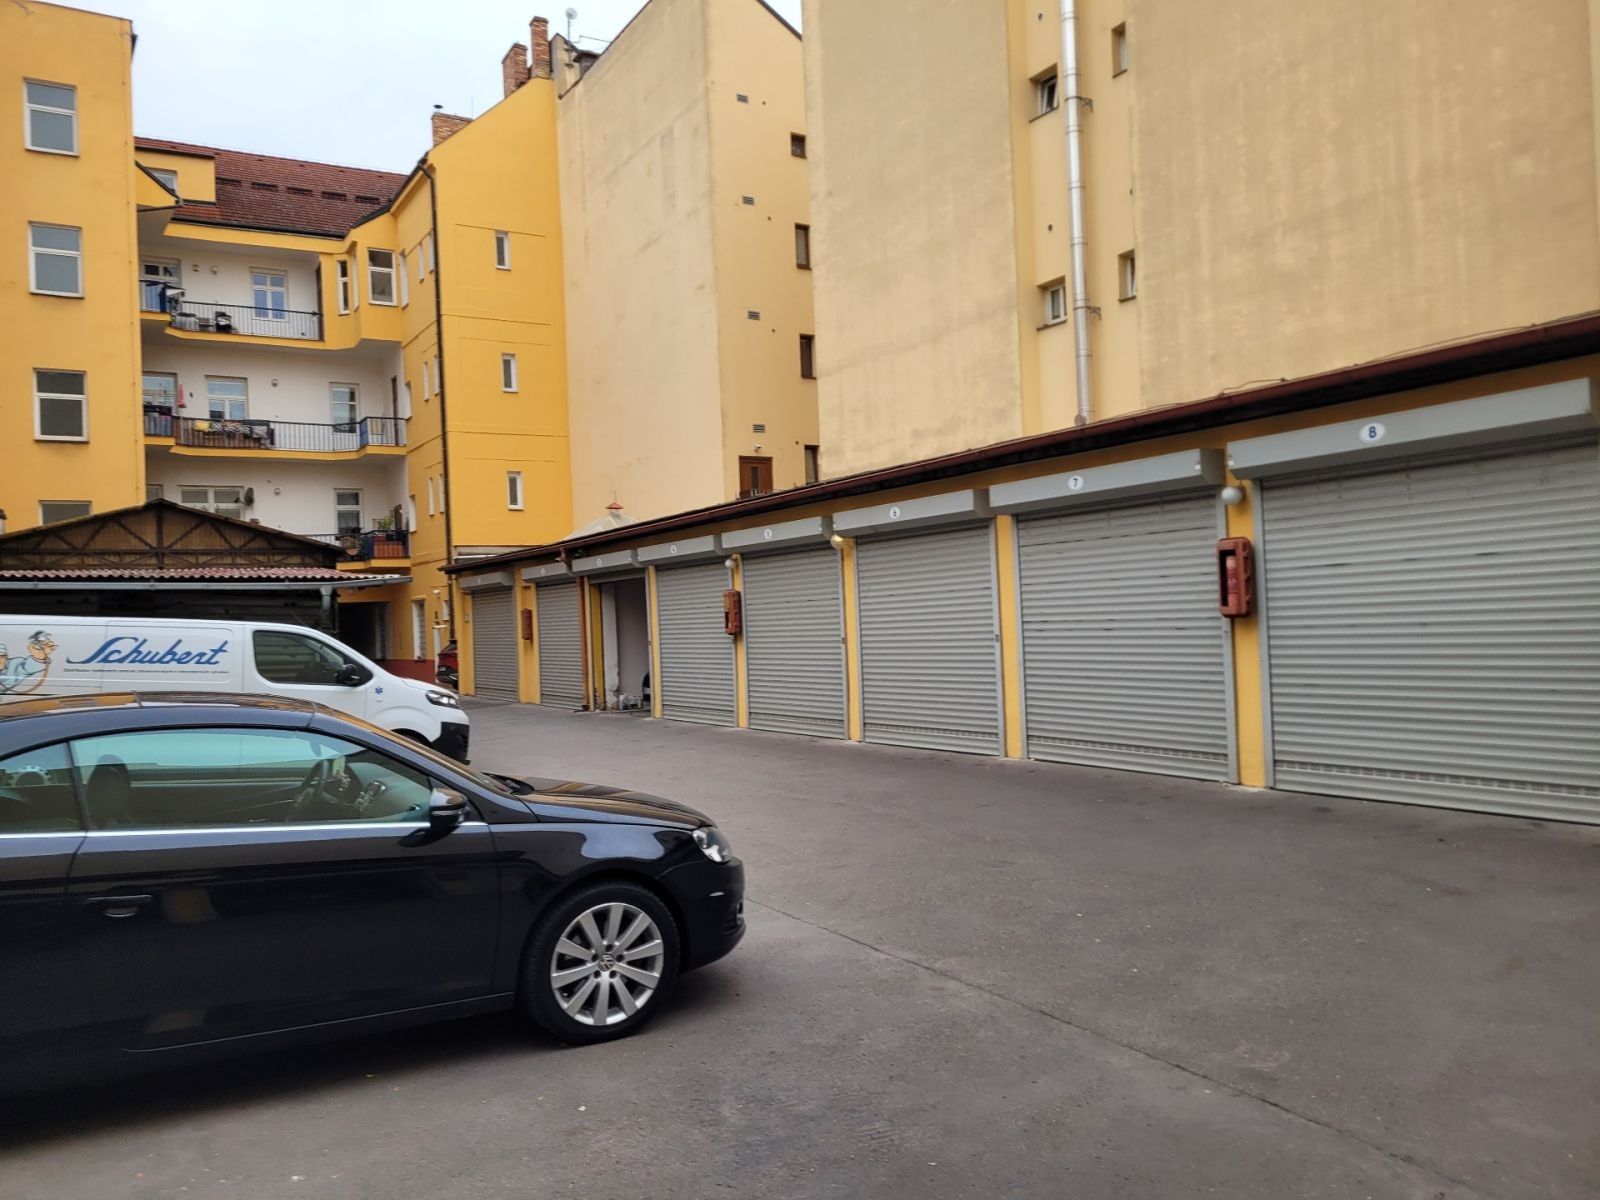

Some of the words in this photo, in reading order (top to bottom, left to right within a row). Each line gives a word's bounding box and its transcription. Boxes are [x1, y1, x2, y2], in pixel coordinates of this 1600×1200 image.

[1368, 425, 1377, 439] 8
[1072, 477, 1079, 488] 7
[65, 636, 229, 666] Schubert
